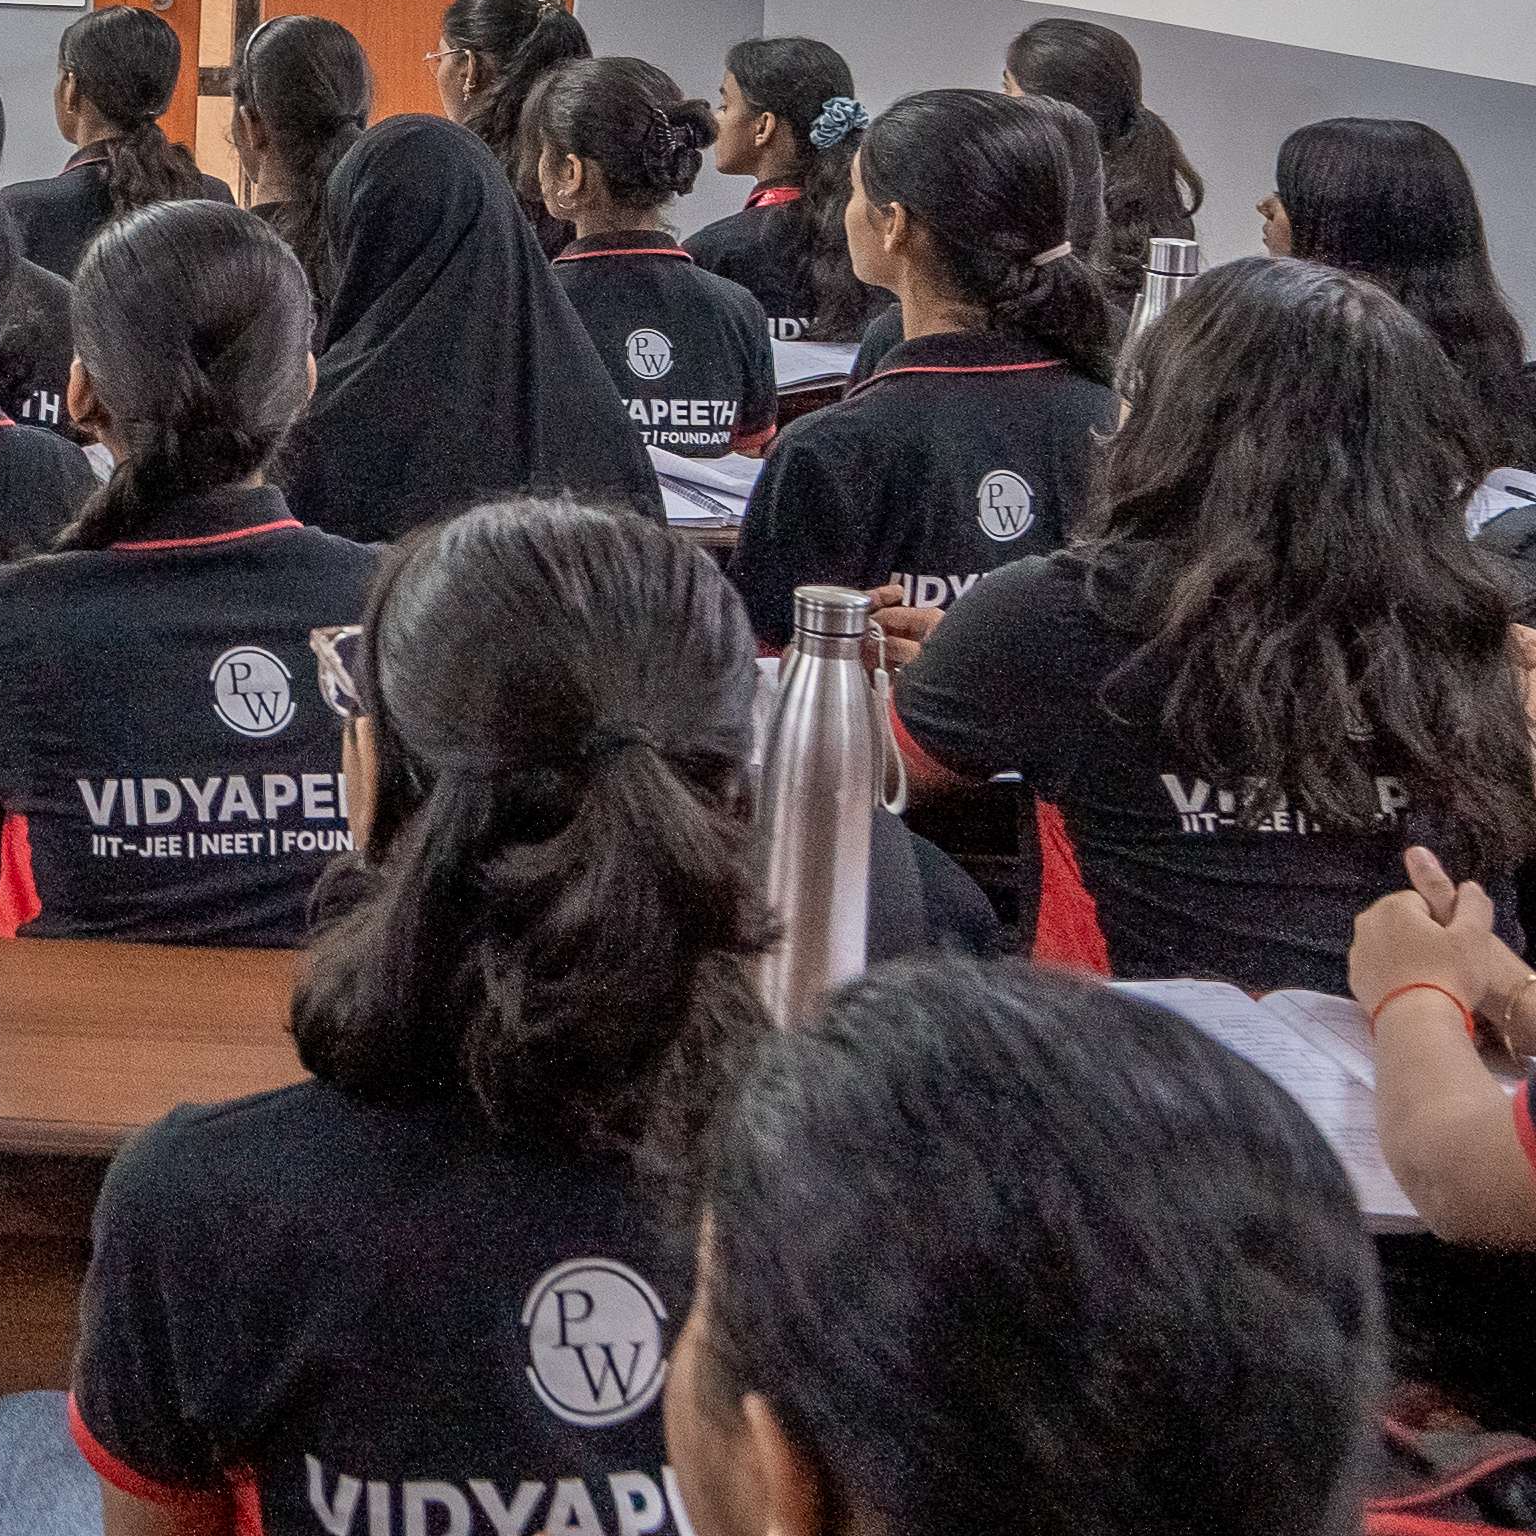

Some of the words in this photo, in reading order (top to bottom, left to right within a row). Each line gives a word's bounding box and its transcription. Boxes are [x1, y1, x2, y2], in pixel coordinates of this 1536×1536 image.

[622, 399, 737, 426] APEETH
[78, 773, 349, 826] VIDYAPE
[92, 834, 182, 858] IIT-JEE
[202, 833, 263, 855] NEET
[305, 1453, 694, 1536] VIDYAP
